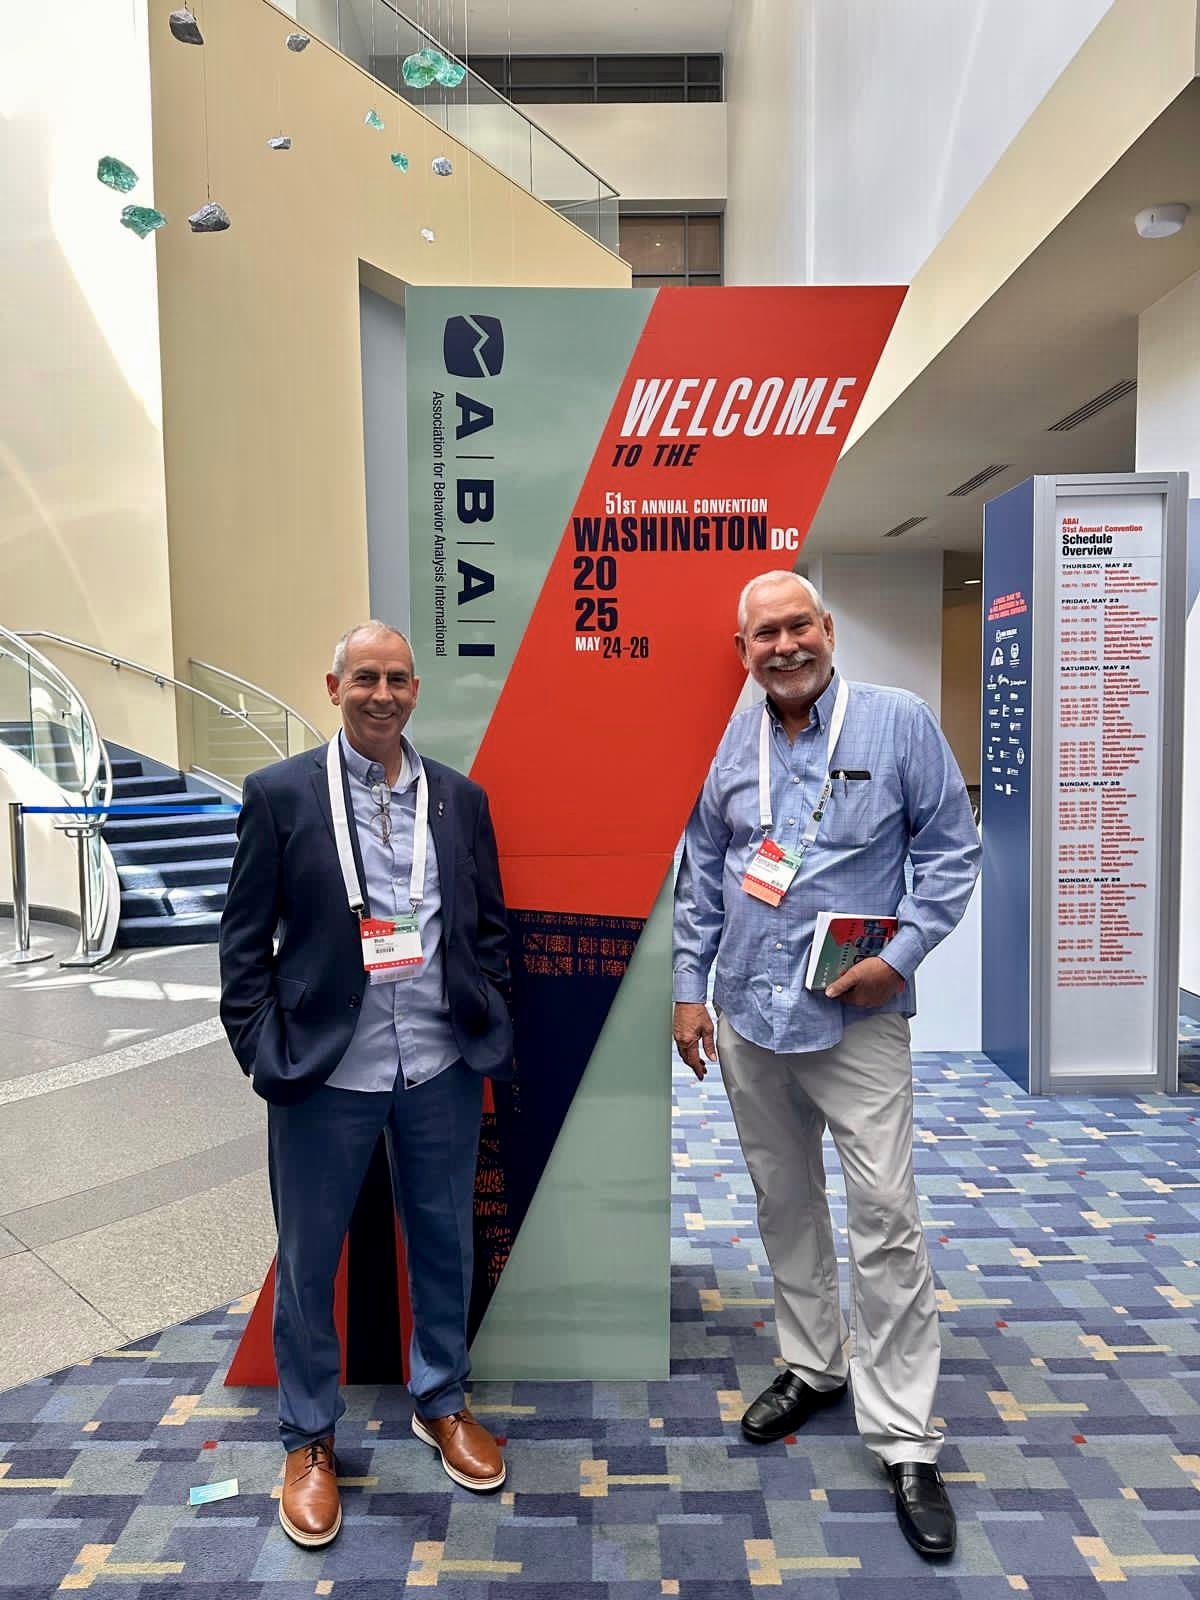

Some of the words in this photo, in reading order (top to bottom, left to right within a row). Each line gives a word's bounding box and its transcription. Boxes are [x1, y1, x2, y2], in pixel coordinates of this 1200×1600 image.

[619, 377, 856, 437] WELCOME
[432, 391, 445, 458] Association
[433, 462, 445, 478] for
[611, 444, 643, 467] TO
[652, 444, 700, 467] THE
[433, 482, 446, 533] Behavior
[605, 492, 636, 515] 51ST
[641, 500, 688, 514] ANNUAL
[693, 498, 768, 514] CONVENTION
[573, 516, 767, 552] WASHINGTON
[771, 528, 799, 550] DC
[1062, 533, 1113, 545] Schedule
[1078, 525, 1103, 533] Annual
[1104, 524, 1143, 532] Convention
[432, 534, 447, 582] Analysis
[1062, 545, 1113, 556] Overview
[573, 556, 617, 590] 20
[435, 586, 447, 656] International
[575, 598, 618, 632] 25
[575, 636, 600, 651] MAY
